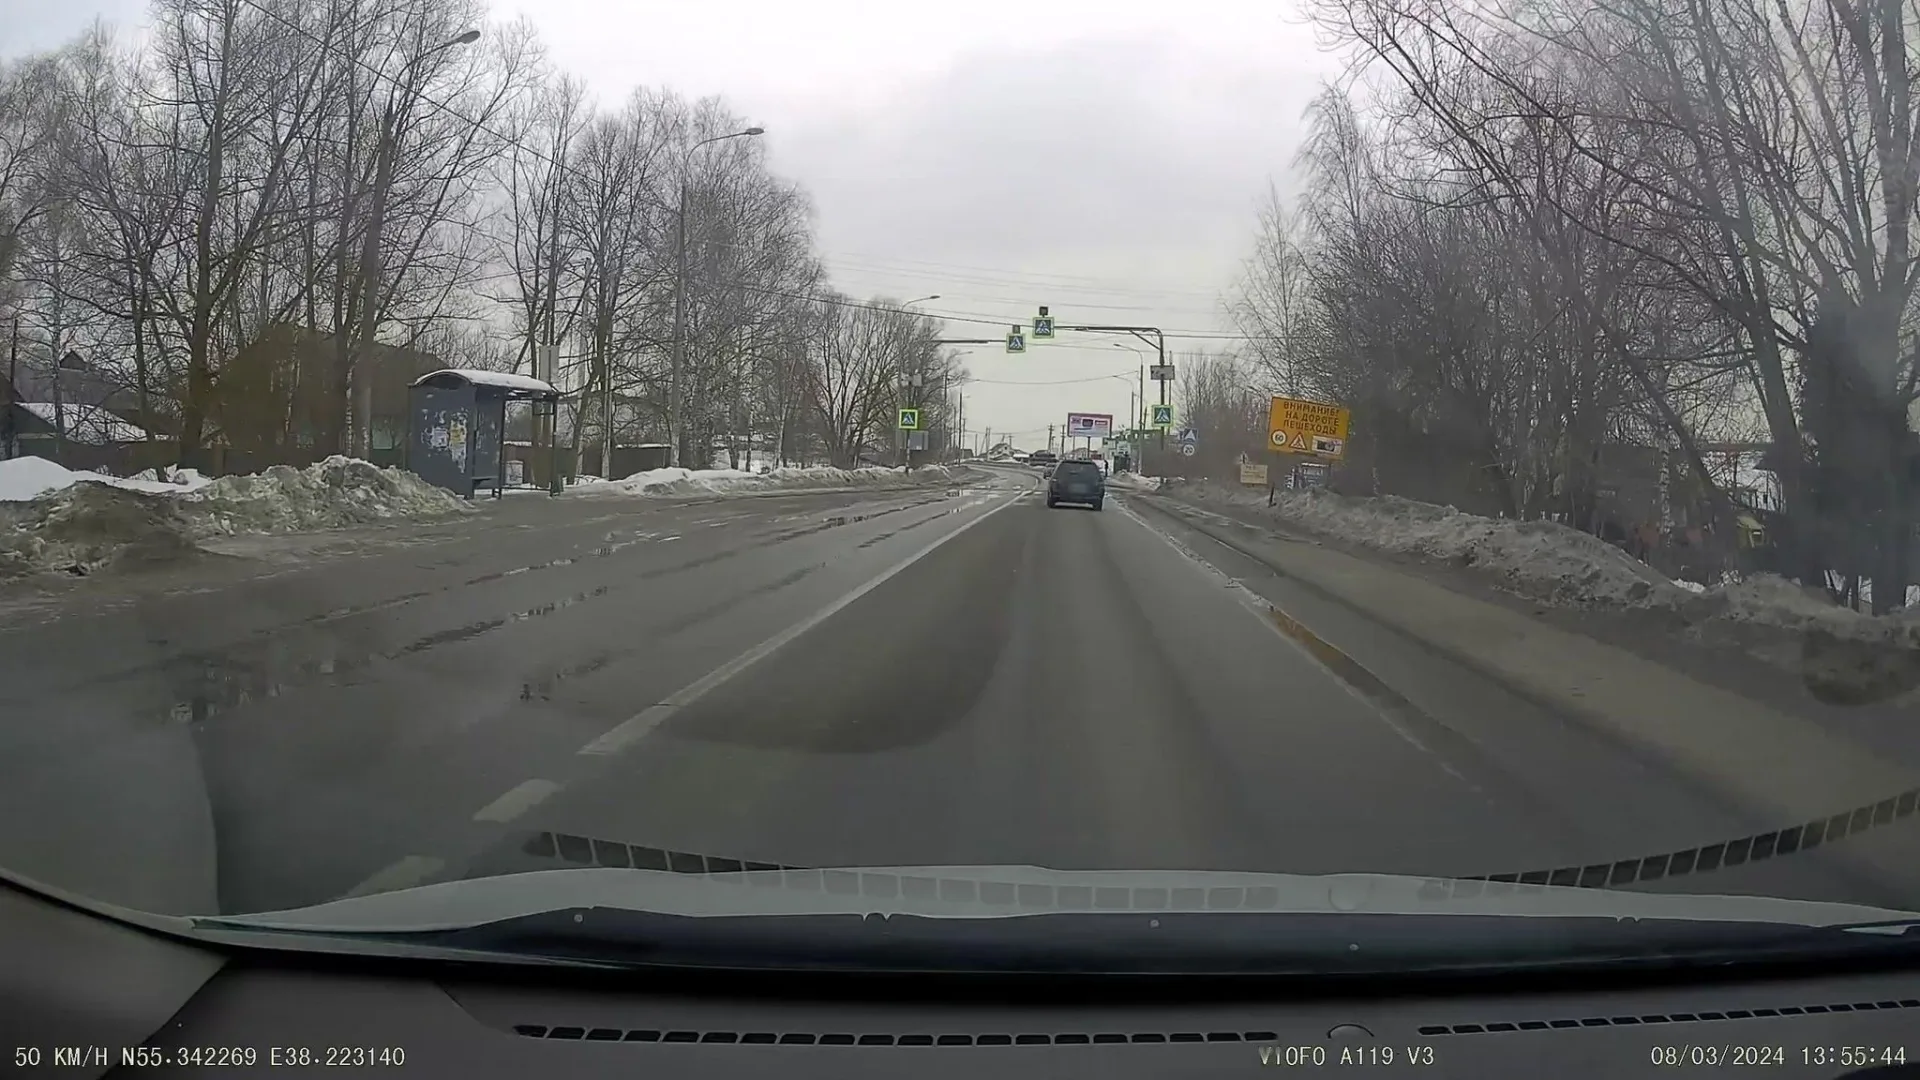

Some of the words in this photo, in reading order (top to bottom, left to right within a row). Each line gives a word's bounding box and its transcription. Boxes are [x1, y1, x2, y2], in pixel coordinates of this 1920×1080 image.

[1283, 401, 1340, 416] ВНИМАНИЕ!
[1285, 411, 1298, 420] НА
[1302, 413, 1340, 426] ДОРОГЕ
[1283, 420, 1337, 435] ПЕШЕХОДЫ
